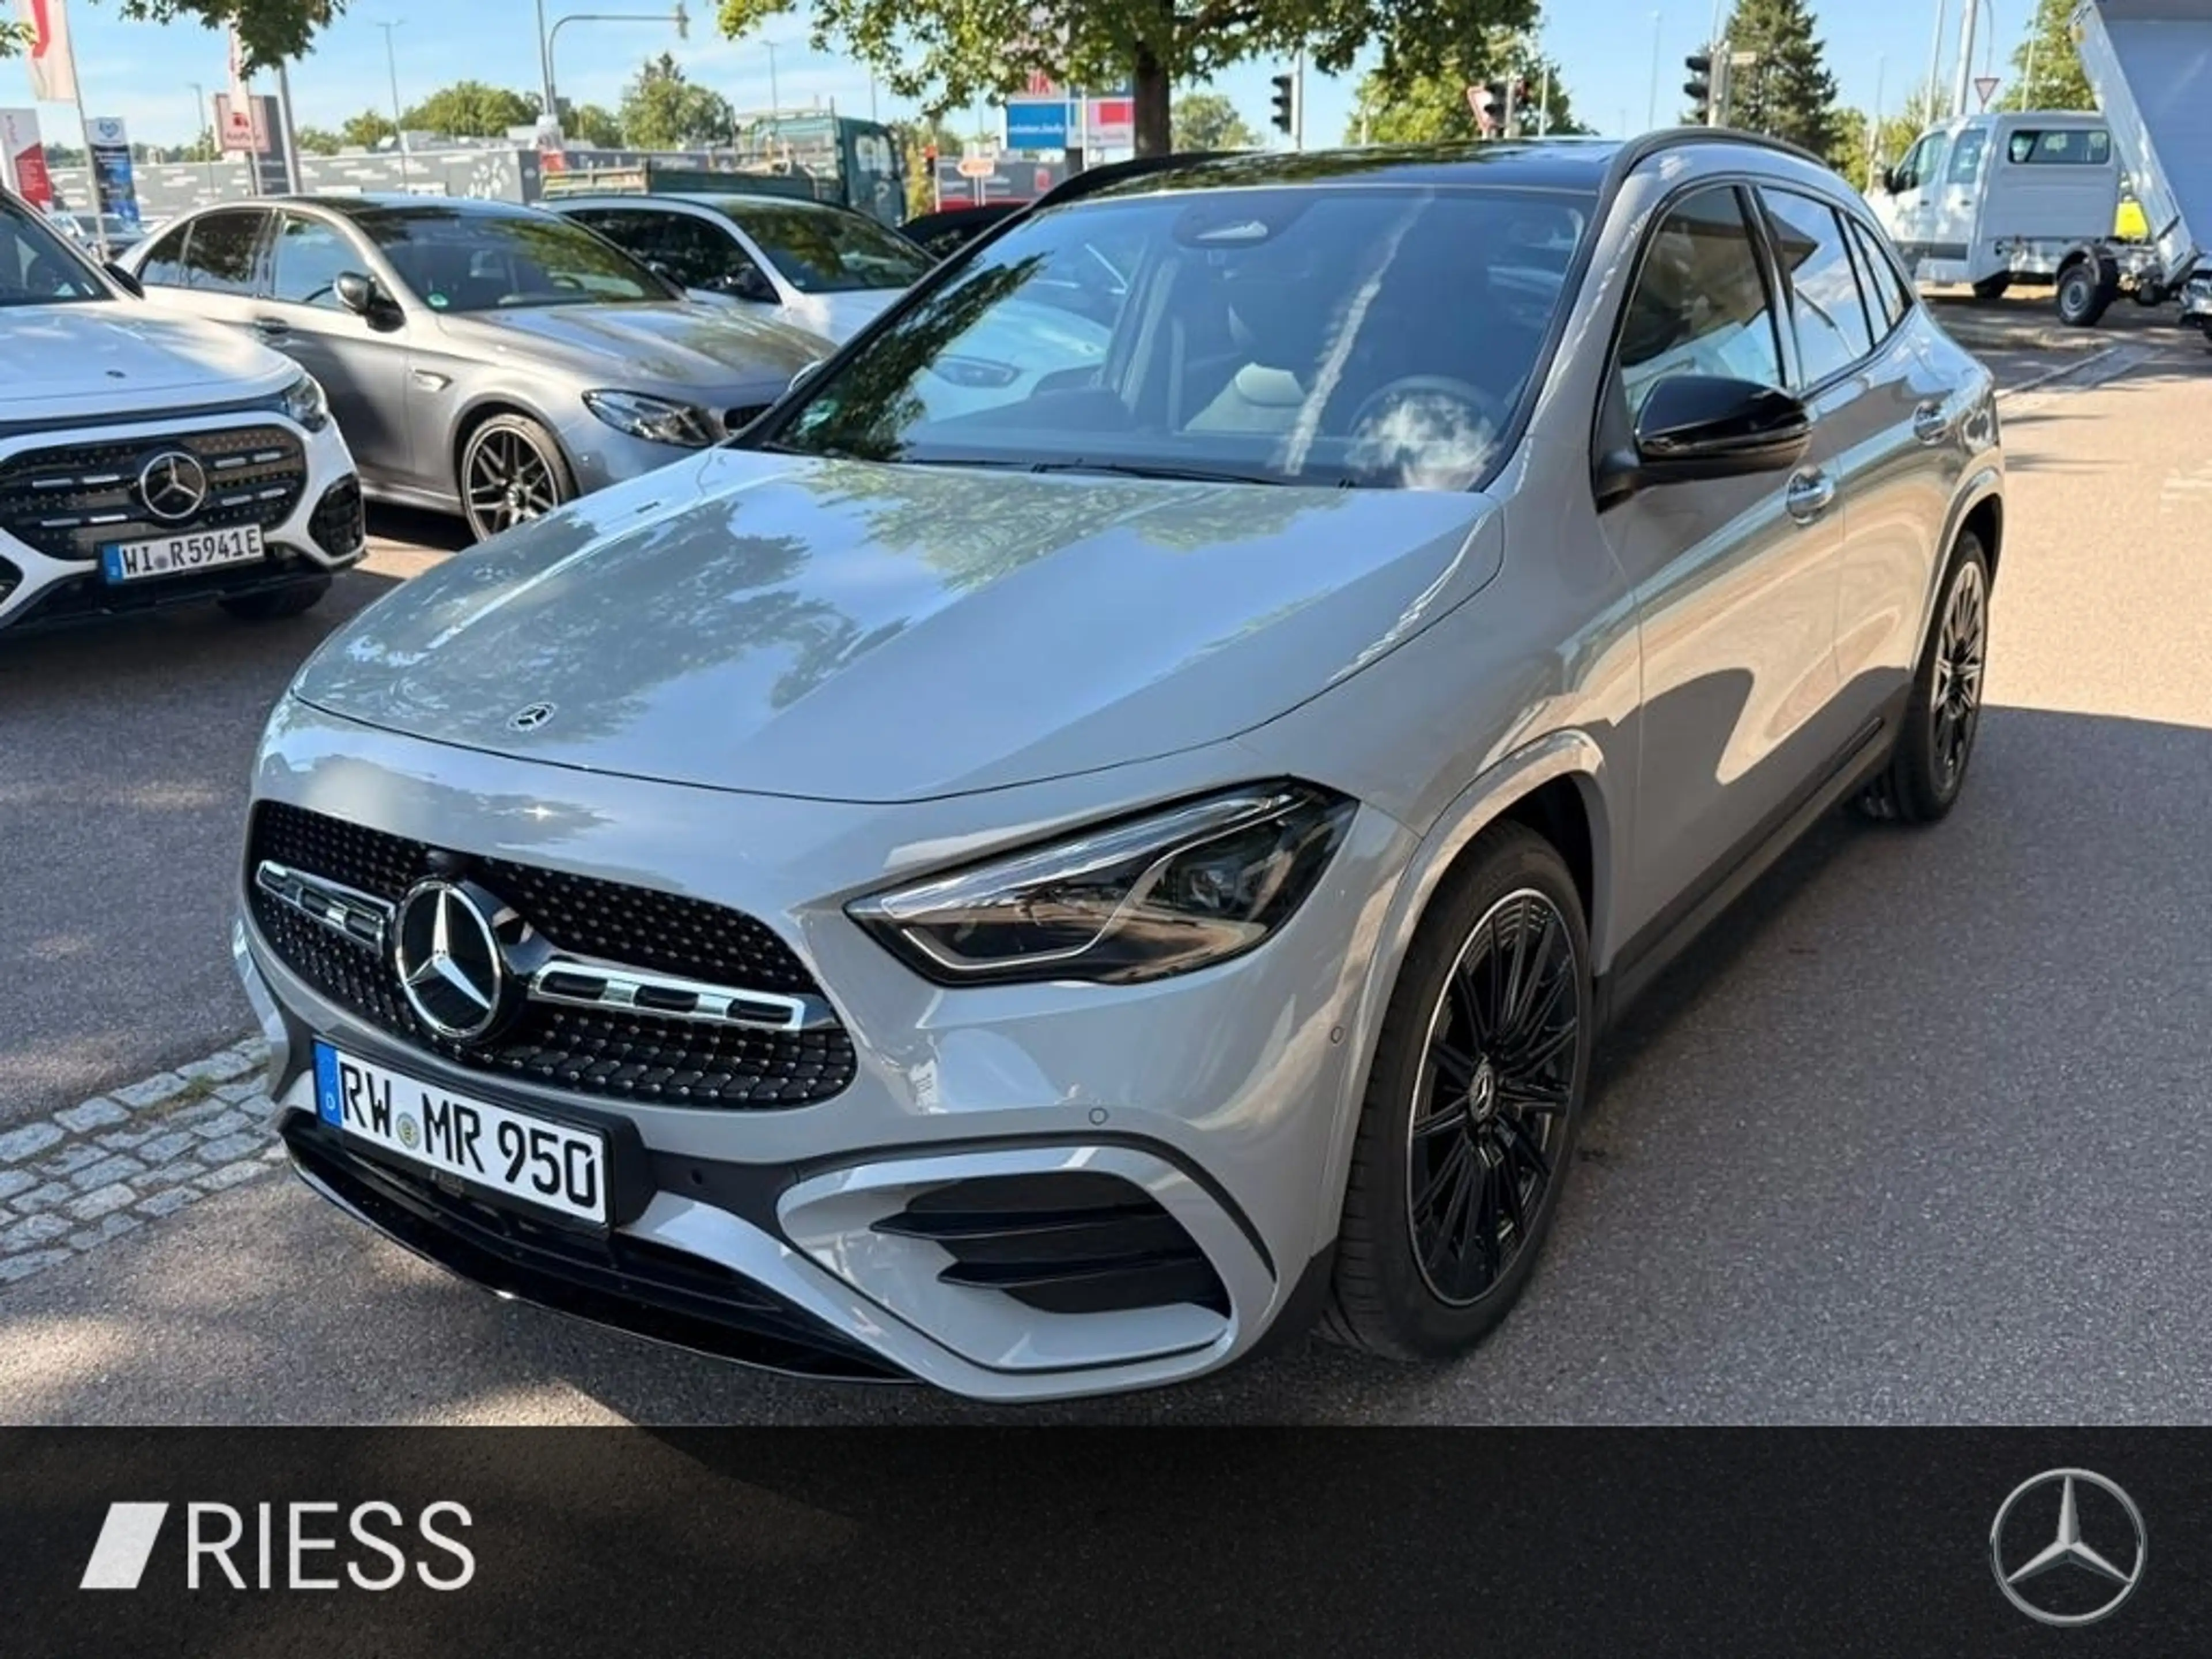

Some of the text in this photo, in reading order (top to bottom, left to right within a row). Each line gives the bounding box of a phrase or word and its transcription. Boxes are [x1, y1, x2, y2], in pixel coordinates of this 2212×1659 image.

[123, 547, 152, 574] WI
[339, 1061, 597, 1209] RW MR 950
